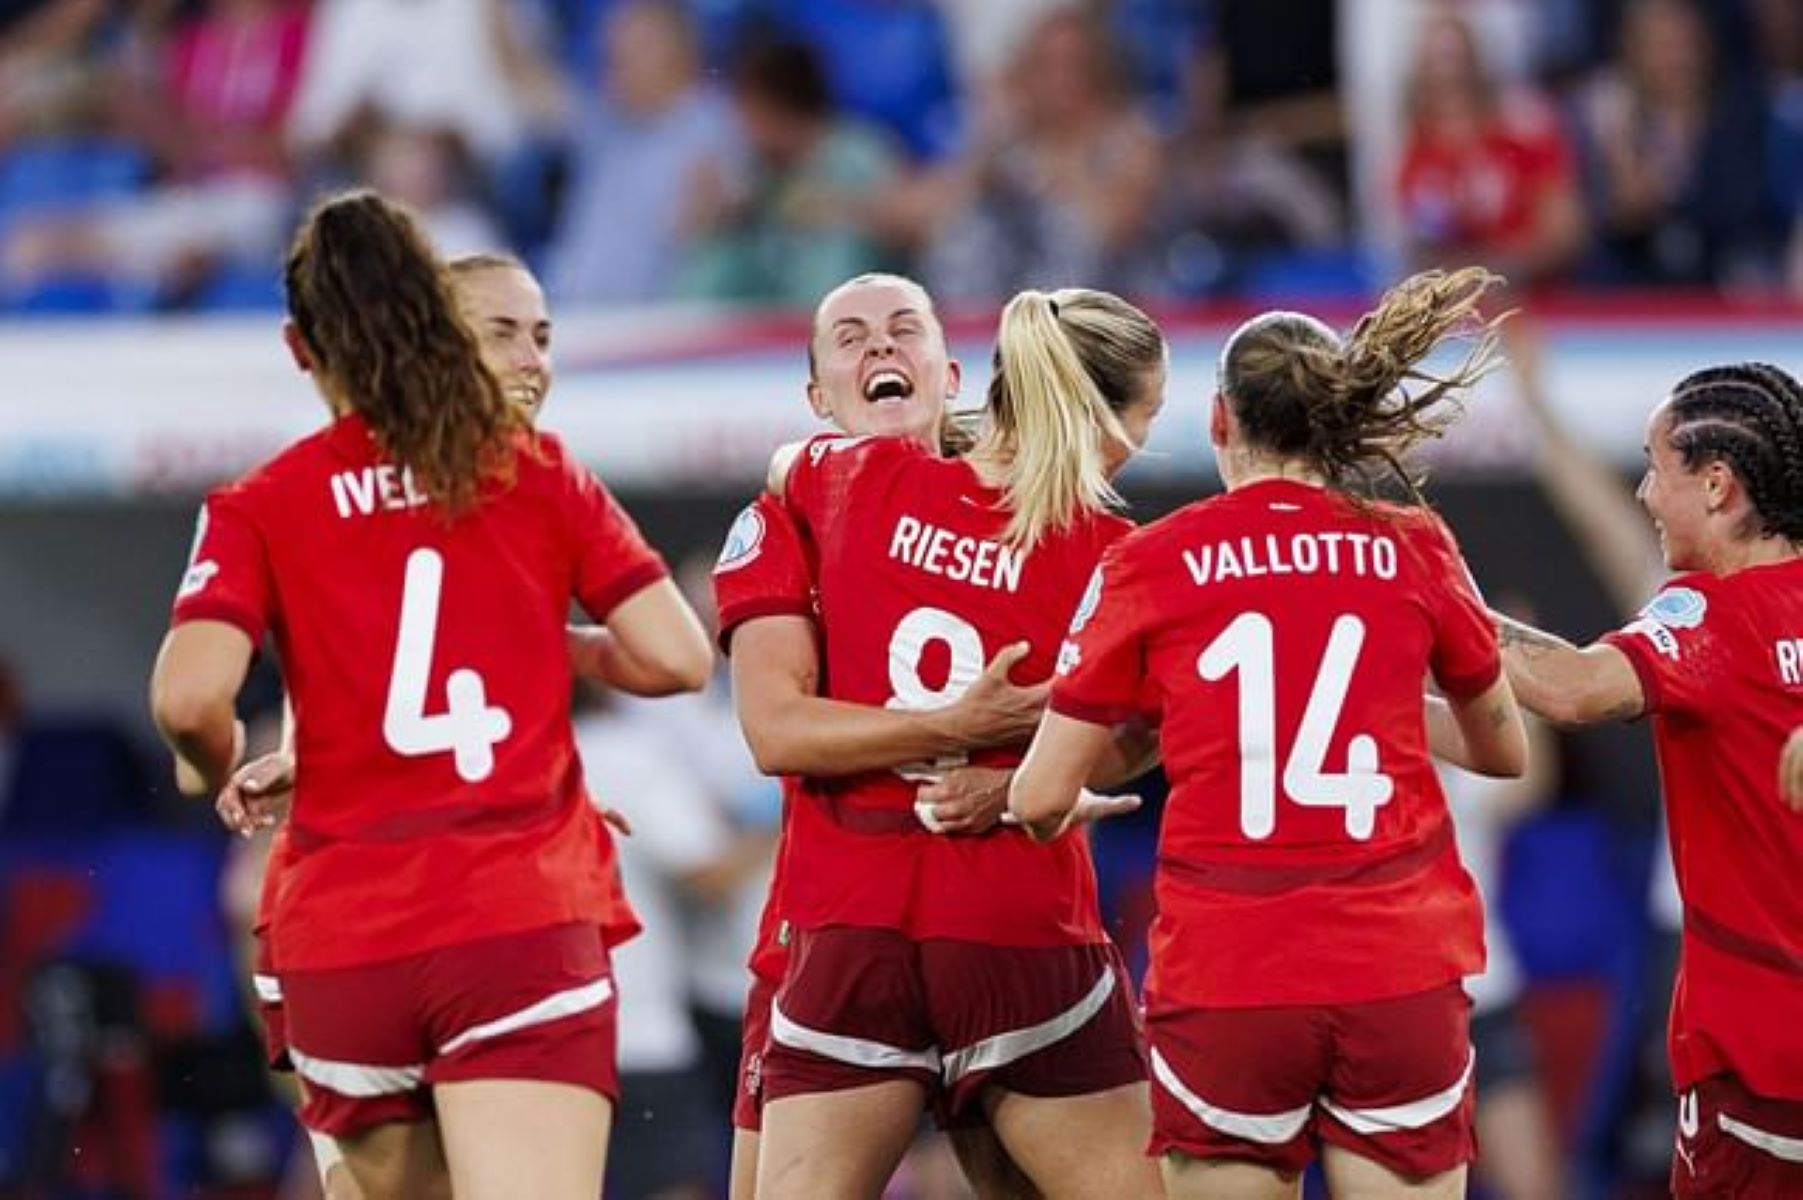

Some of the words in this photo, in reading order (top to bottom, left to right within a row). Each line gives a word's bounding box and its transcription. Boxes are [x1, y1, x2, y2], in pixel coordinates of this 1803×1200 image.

[331, 464, 428, 518] IVEL
[888, 515, 1024, 592] RIESEN
[1182, 533, 1397, 586] VALLOTTO
[383, 547, 512, 781] 4
[1196, 611, 1394, 840] 14
